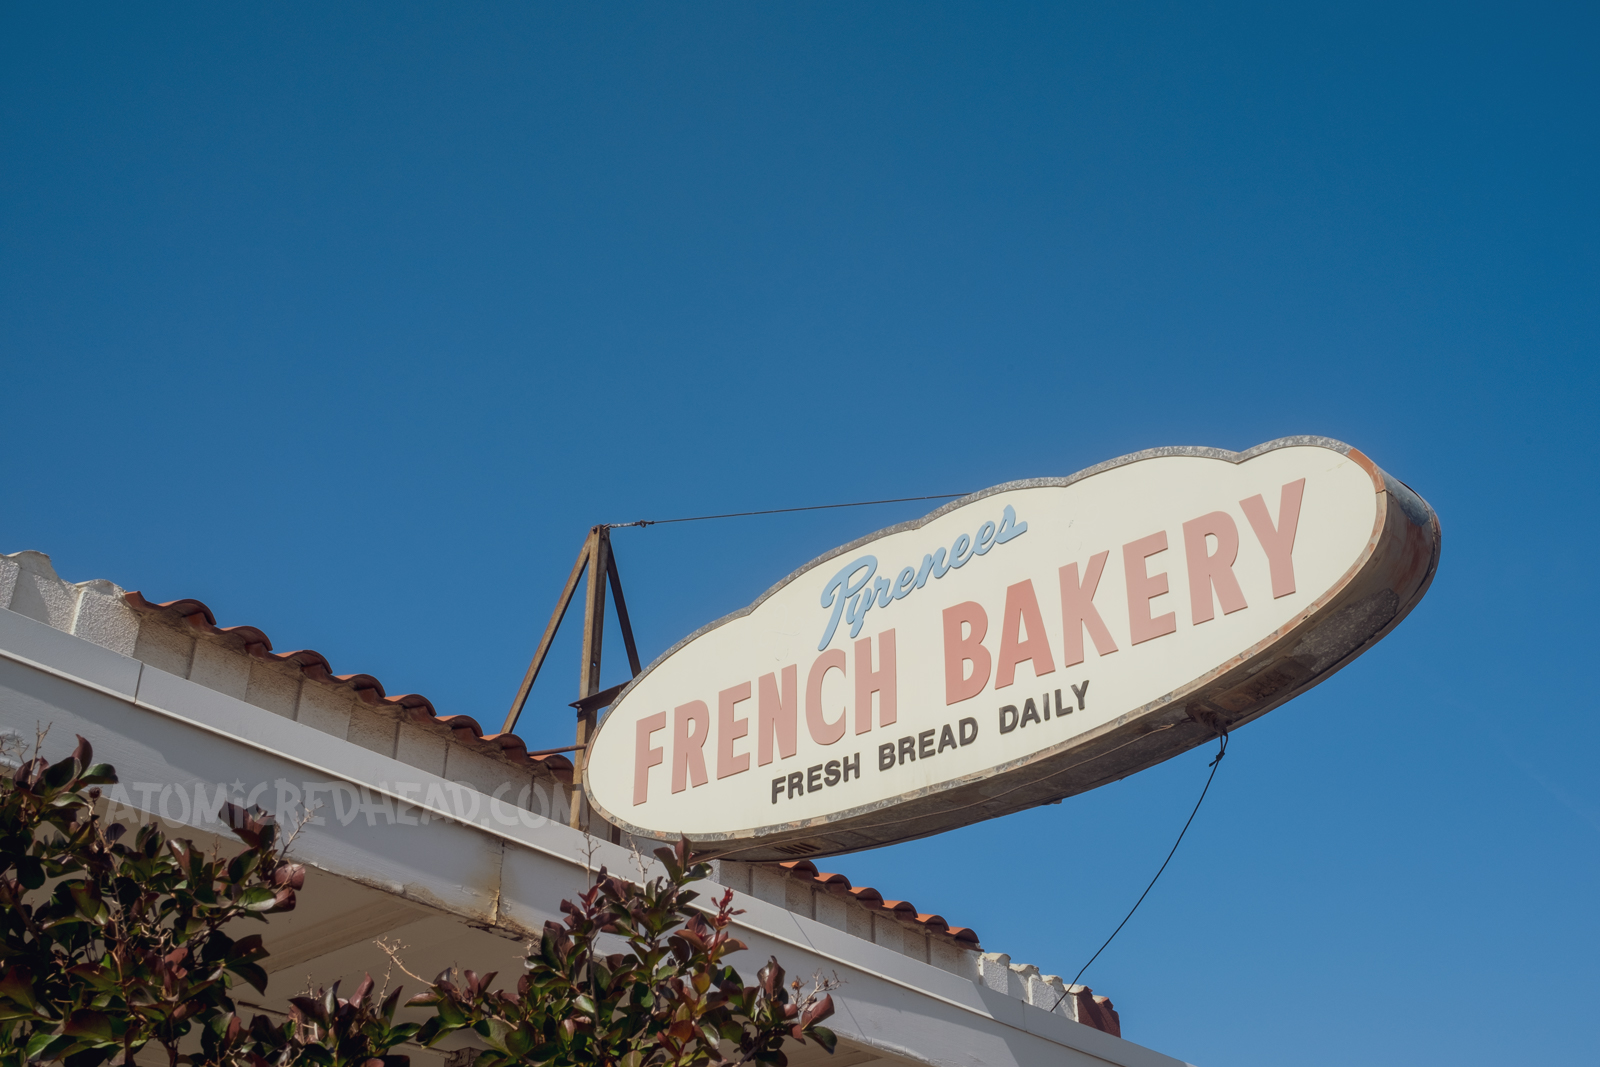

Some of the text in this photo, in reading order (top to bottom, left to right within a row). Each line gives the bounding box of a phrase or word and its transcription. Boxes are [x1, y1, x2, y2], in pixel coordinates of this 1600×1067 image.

[632, 477, 1306, 806] FRENCH BAKERY
[818, 504, 1028, 652] Pyrenees
[771, 679, 1090, 804] FRESH BREAD DAILY
